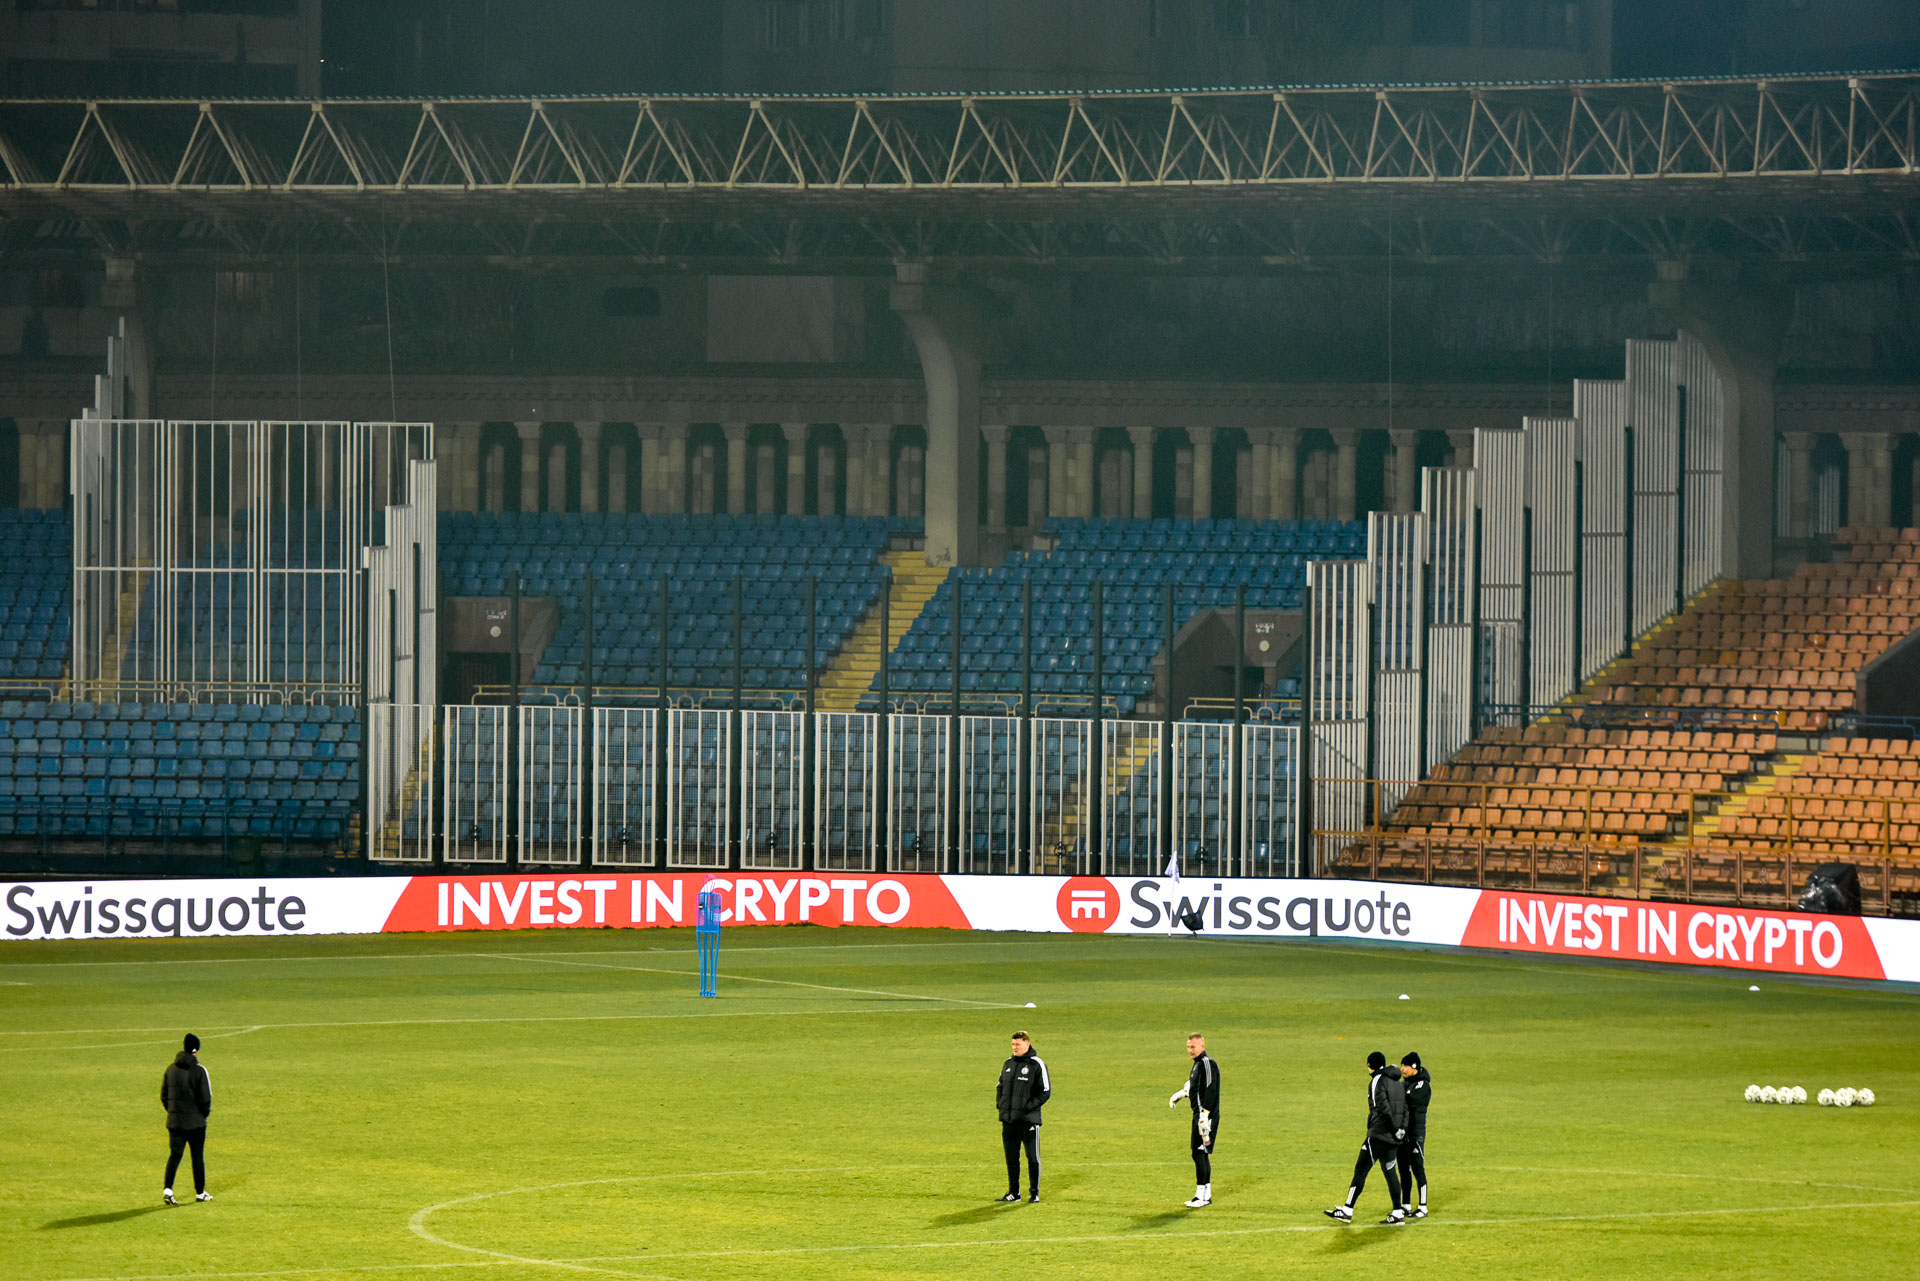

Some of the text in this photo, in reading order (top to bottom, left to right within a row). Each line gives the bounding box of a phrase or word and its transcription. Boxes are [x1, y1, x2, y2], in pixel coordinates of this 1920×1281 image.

[5, 885, 306, 937] Swissquote
[437, 880, 617, 926] INVEST
[630, 879, 683, 923] IN
[1498, 897, 1843, 969] INVEST IN CRYPTO
